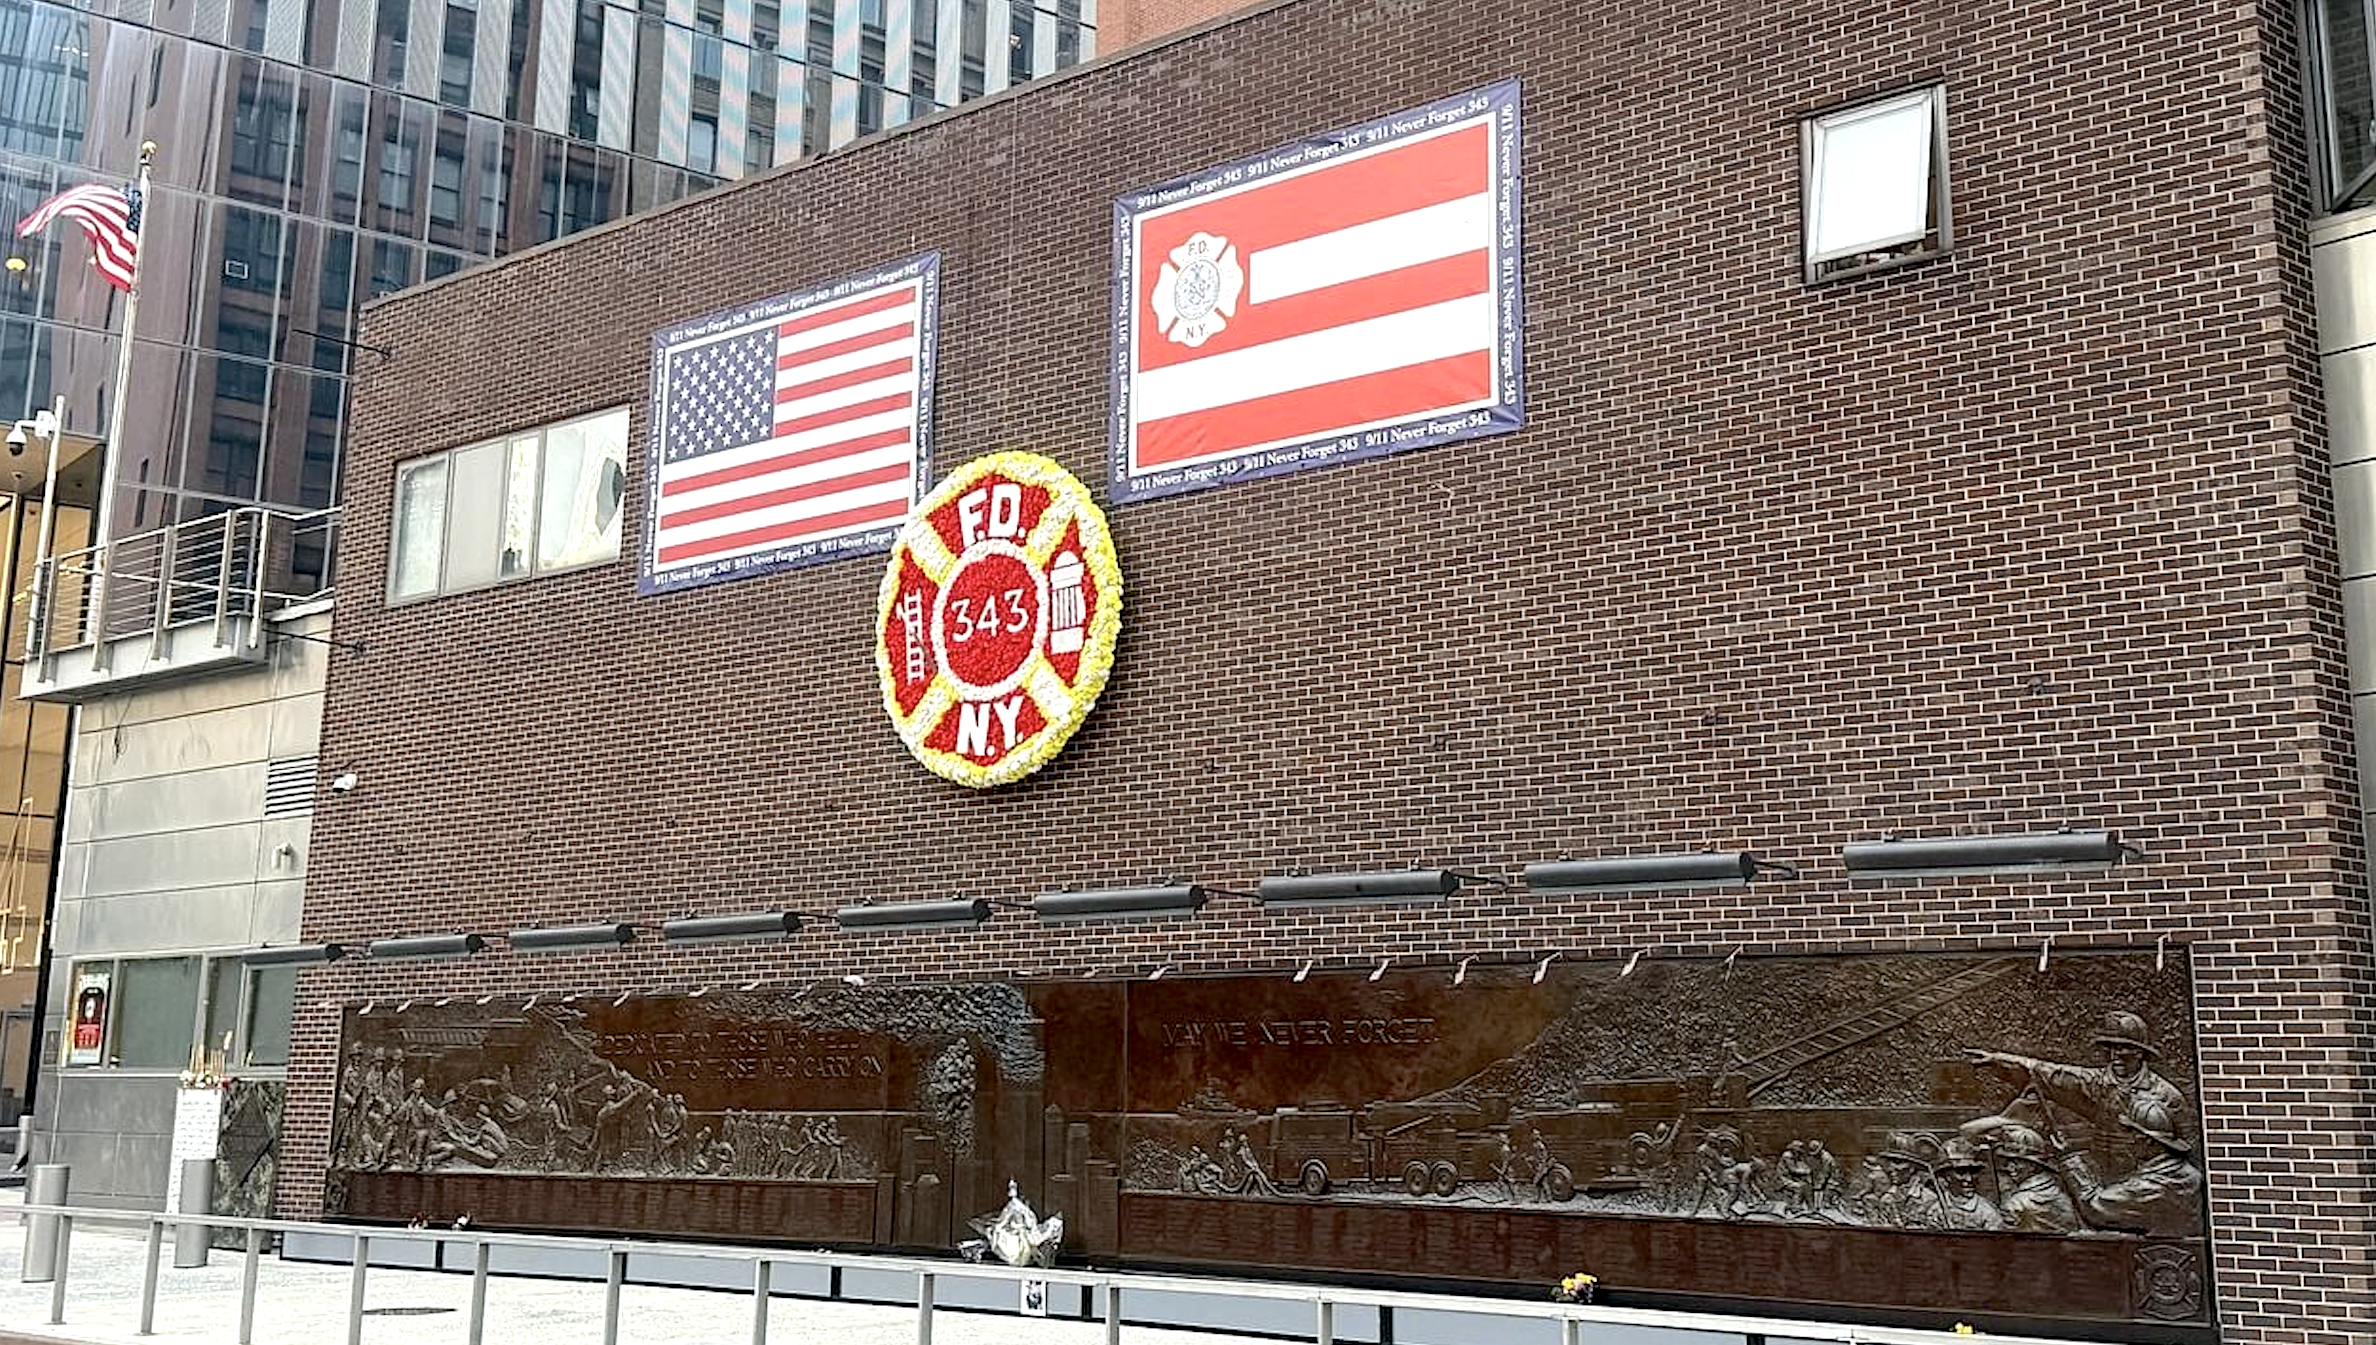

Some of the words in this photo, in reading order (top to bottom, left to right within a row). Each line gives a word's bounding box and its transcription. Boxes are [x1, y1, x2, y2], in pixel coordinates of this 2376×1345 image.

[1137, 195, 1157, 209] 9/11
[1158, 187, 1190, 203] Never
[1190, 177, 1222, 194] Forget
[1222, 168, 1242, 185] 343
[1247, 161, 1268, 177] 9/11
[1270, 152, 1302, 170] Never
[1304, 142, 1340, 160] Forget
[1341, 132, 1360, 148] 343
[1366, 126, 1388, 142] 9/11
[1391, 117, 1426, 134] Never
[1427, 105, 1466, 124] Forget
[1468, 97, 1489, 113] 343
[1502, 133, 1513, 176] Never
[1499, 177, 1513, 223] Forget
[1502, 224, 1514, 249] 343
[1118, 280, 1130, 317] Never
[1503, 287, 1515, 330] Never
[1501, 331, 1515, 378] Forget
[1504, 380, 1517, 405] 343
[1115, 417, 1127, 454] Never
[1130, 477, 1150, 492] 9/11
[1152, 472, 1182, 489] Never
[1184, 465, 1218, 482] Forget
[1218, 459, 1238, 475] 343
[1244, 454, 1265, 471] 9/11
[1266, 450, 1299, 466] Never
[1301, 444, 1338, 459] Forget
[1339, 437, 1358, 451] 343
[1365, 432, 1389, 447] 9/11
[1390, 426, 1426, 443] Never
[1428, 418, 1466, 435] Forget
[1467, 410, 1491, 426] 343
[957, 483, 1026, 548] F.D.
[951, 588, 1029, 642] 343
[955, 695, 1024, 756] N.Y.
[1213, 1021, 1247, 1045] WE
[1259, 1020, 1333, 1045] NEVER
[1342, 1018, 1435, 1044] FORGET
